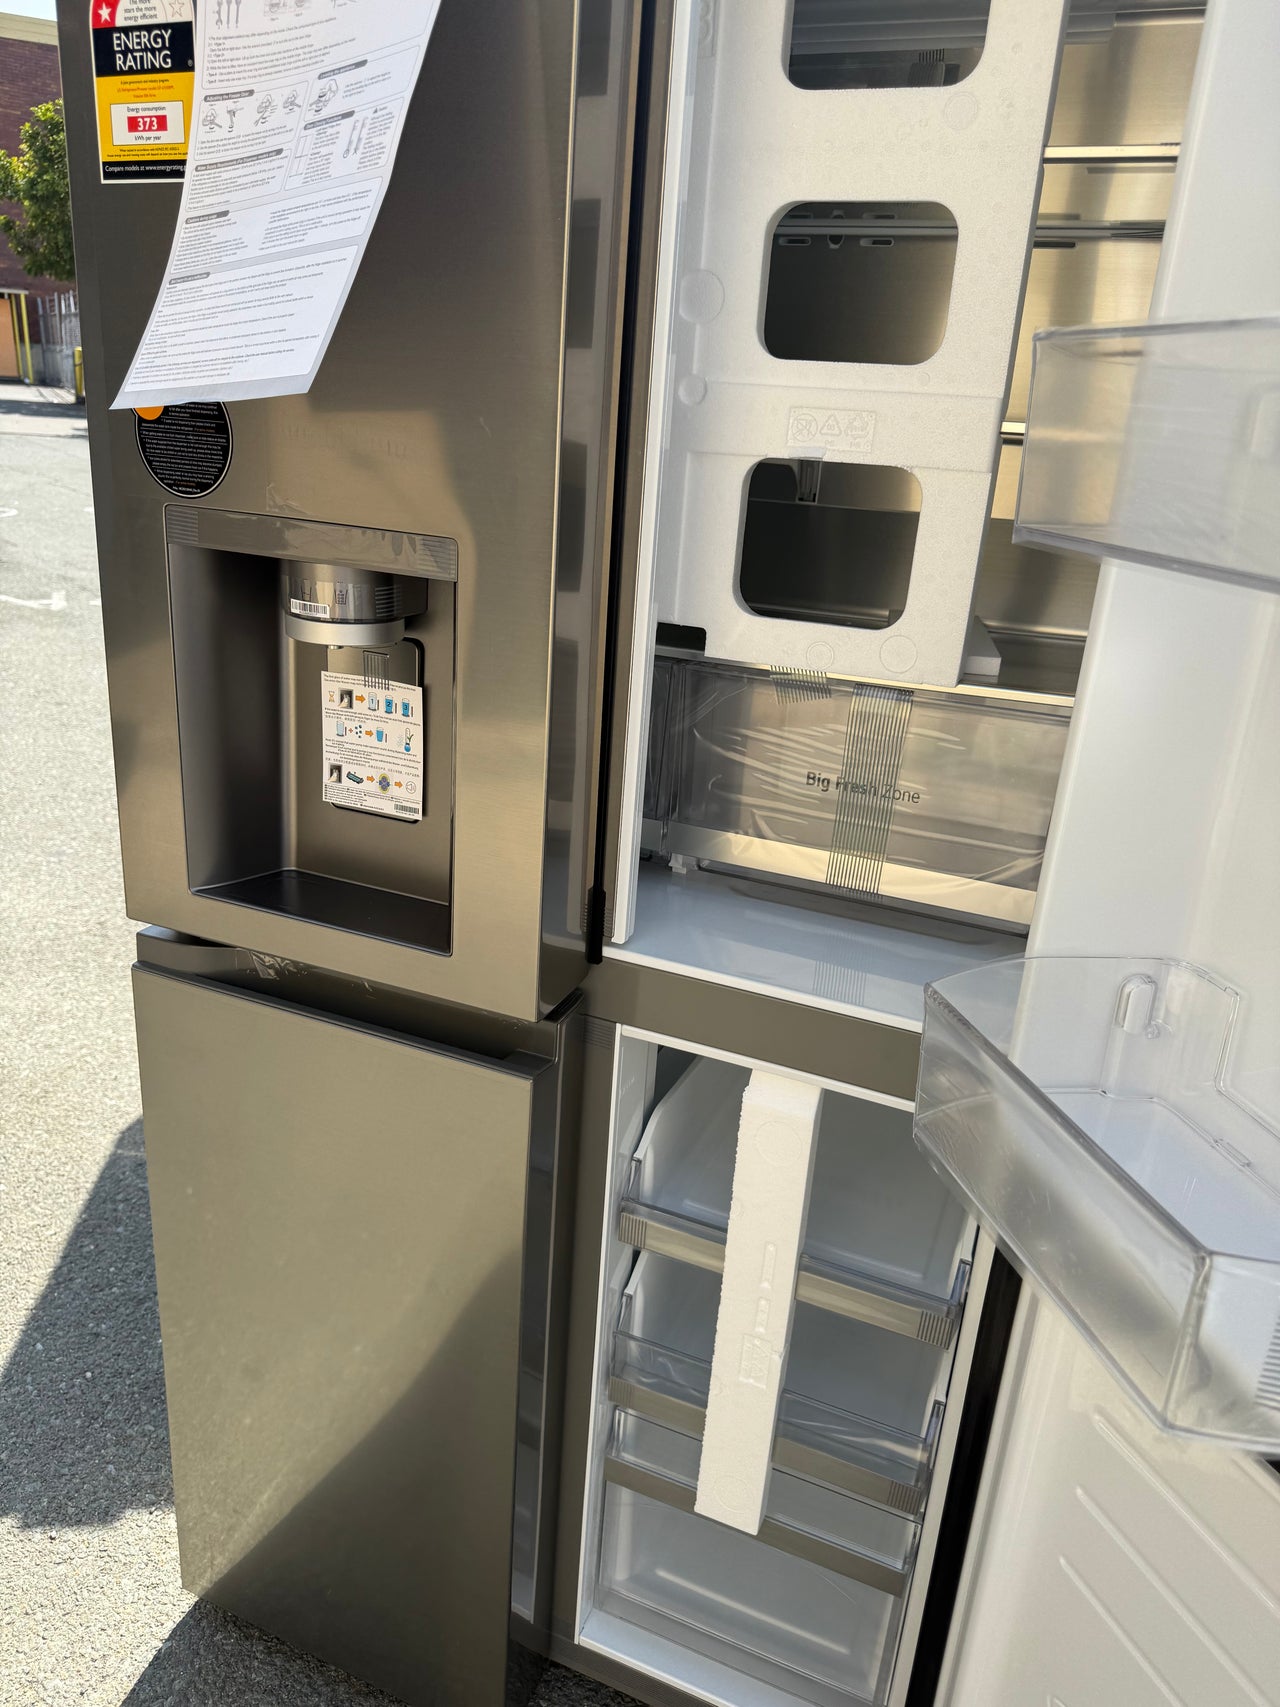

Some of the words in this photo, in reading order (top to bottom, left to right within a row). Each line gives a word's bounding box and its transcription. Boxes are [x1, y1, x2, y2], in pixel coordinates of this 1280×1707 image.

[113, 29, 172, 51] ENERGY
[116, 50, 172, 71] RATING
[137, 117, 158, 130] 373
[806, 771, 830, 792] Big
[836, 777, 877, 797] Fresh
[880, 784, 920, 804] Zone
